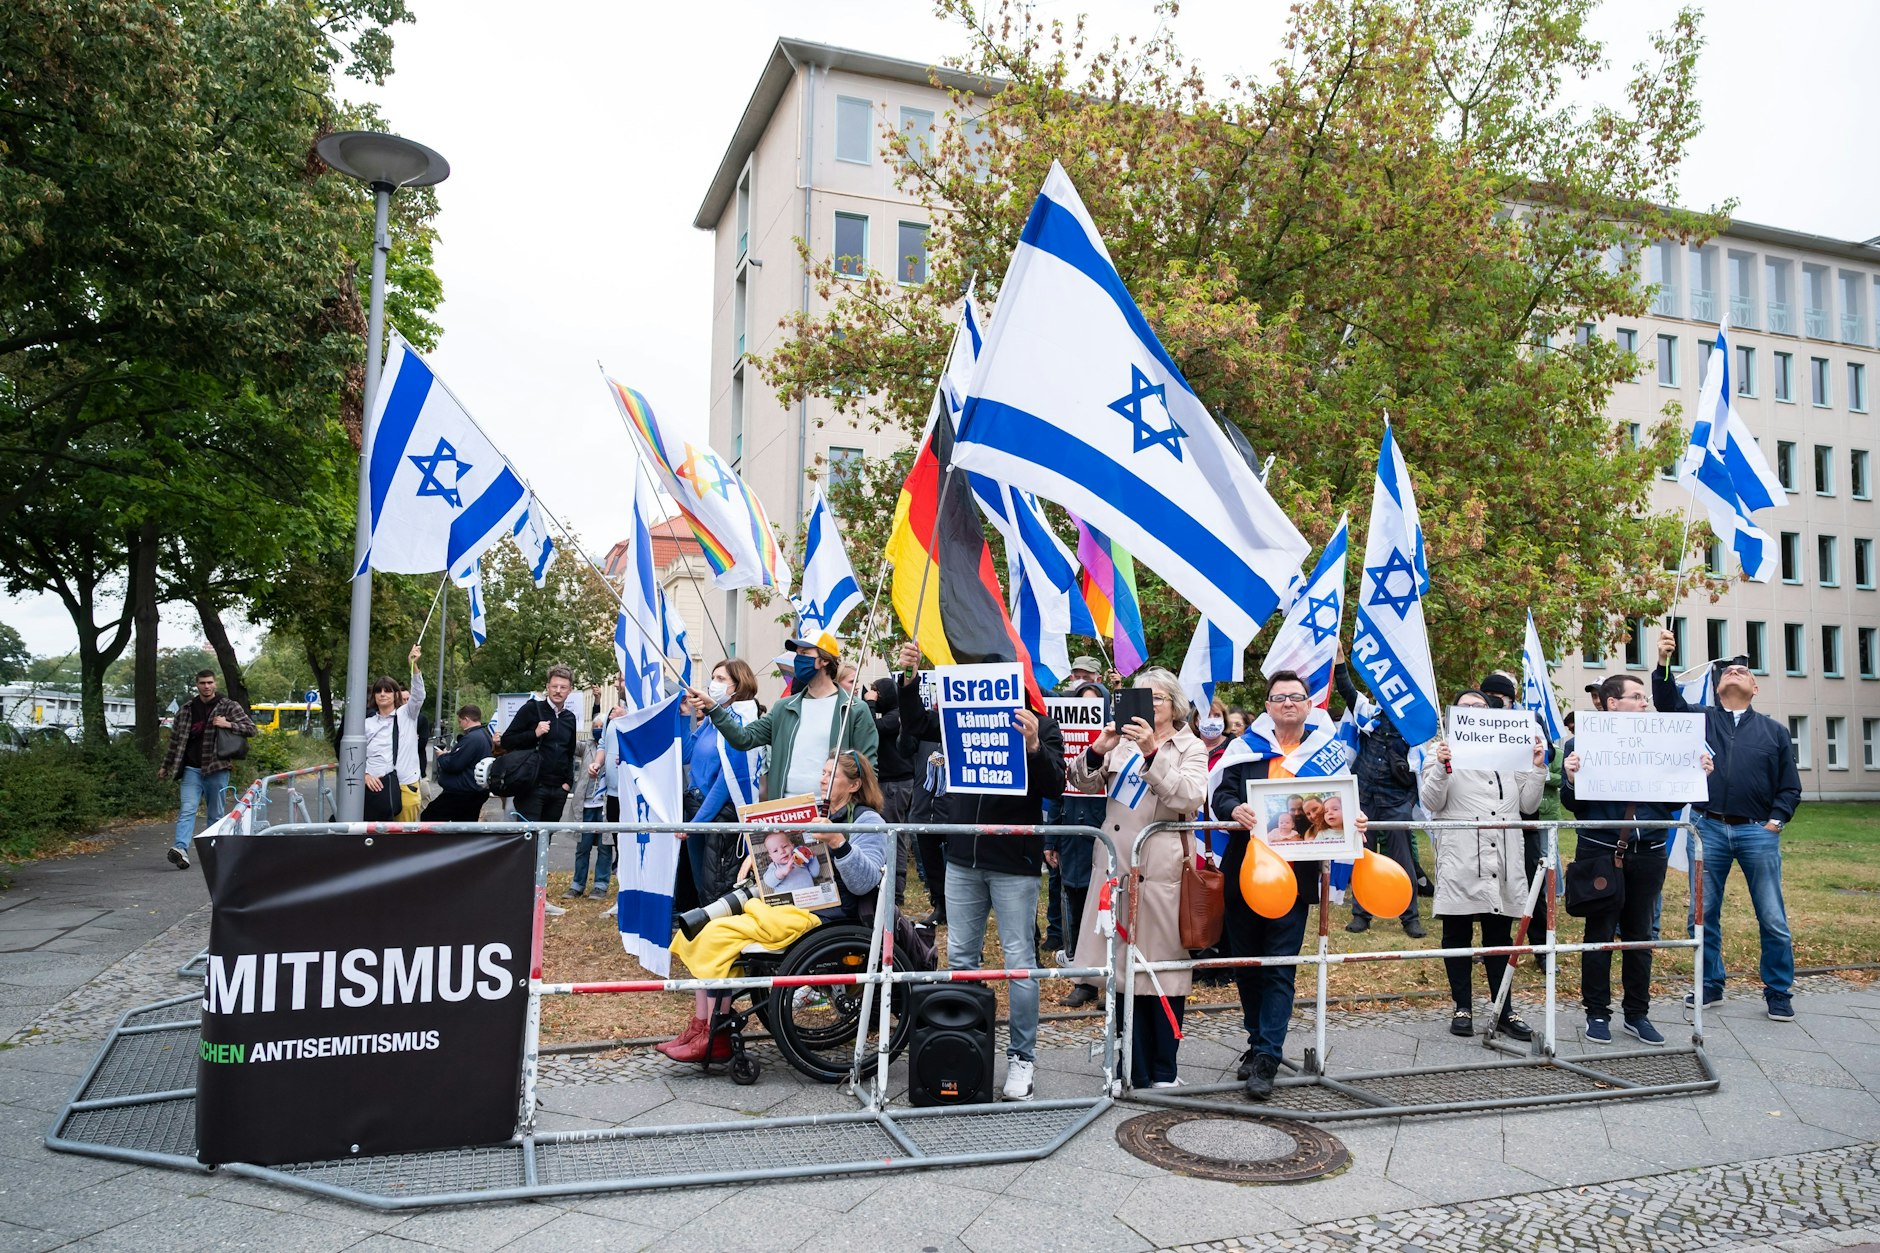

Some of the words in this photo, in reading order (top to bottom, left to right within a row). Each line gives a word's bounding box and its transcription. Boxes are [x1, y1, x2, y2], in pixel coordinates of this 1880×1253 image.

[943, 674, 1019, 702] Israel
[956, 711, 1011, 729] kämpft
[1457, 714, 1475, 726] We
[1479, 718, 1529, 730] support
[1582, 716, 1618, 734] KEINE
[1626, 717, 1694, 734] TOLERANZ
[962, 732, 1009, 748] gegen
[1454, 730, 1495, 743] Volker
[1499, 733, 1532, 744] Beck
[1617, 737, 1645, 748] FÜR
[963, 748, 1009, 766] Terror
[1582, 749, 1696, 769] ANTISEMITISMUS!
[961, 766, 976, 783] in
[979, 766, 1013, 784] Gaza
[203, 942, 513, 1015] MITISMUS
[249, 1030, 440, 1063] ANTISEMITISMUS
